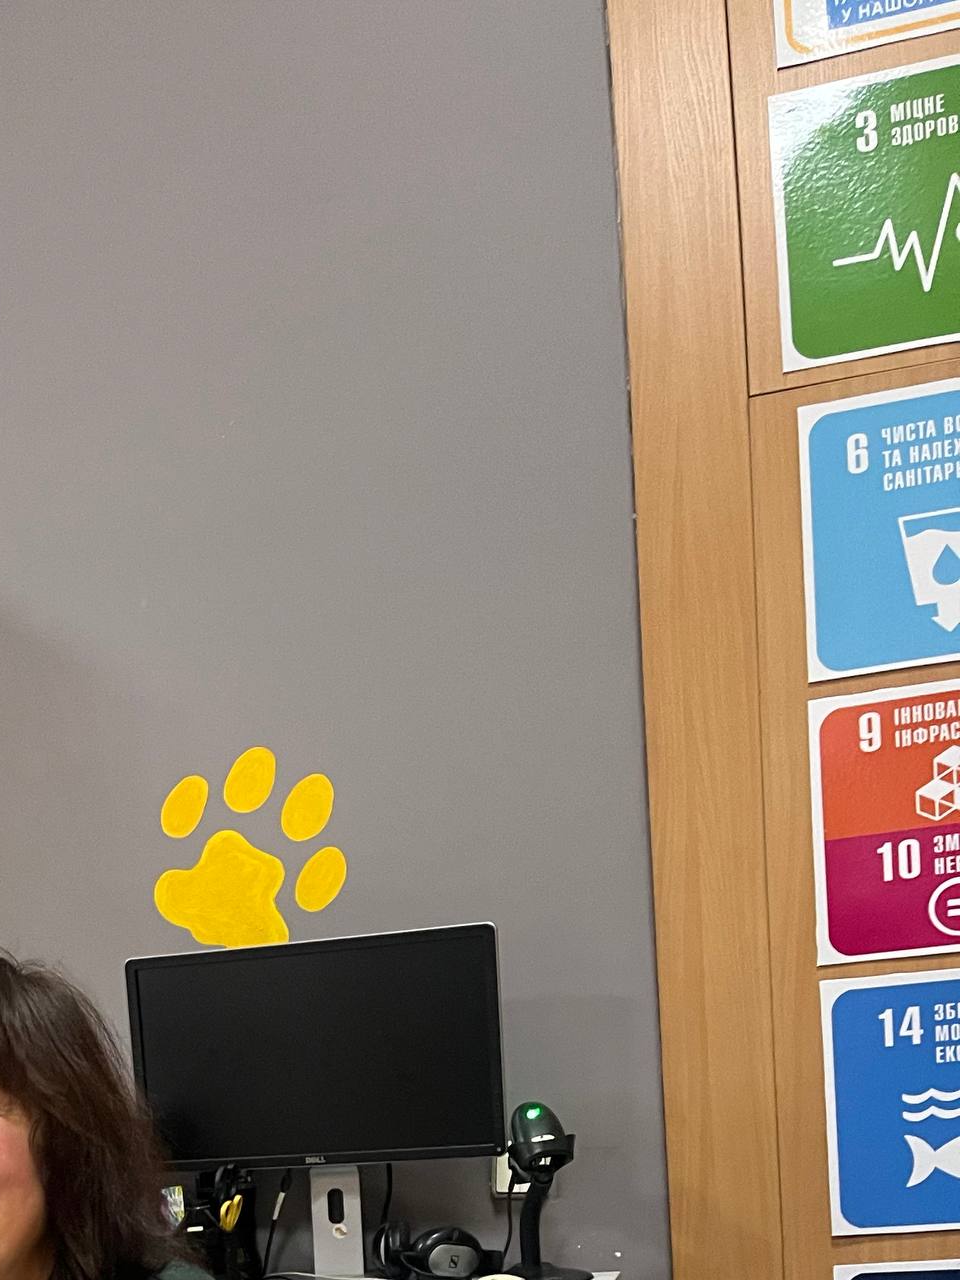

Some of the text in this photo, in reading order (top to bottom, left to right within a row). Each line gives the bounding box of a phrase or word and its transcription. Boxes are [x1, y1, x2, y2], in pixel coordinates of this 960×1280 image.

[841, 7, 851, 23] У
[890, 93, 945, 124] МІЦНЕ
[855, 109, 878, 152] 3
[881, 419, 937, 446] ЧИСТА
[846, 432, 869, 475] 6
[881, 448, 903, 469] ТА
[893, 698, 960, 726] ІННОВА
[858, 711, 882, 753] 9
[876, 838, 921, 882] 10
[878, 1005, 924, 1048] 14
